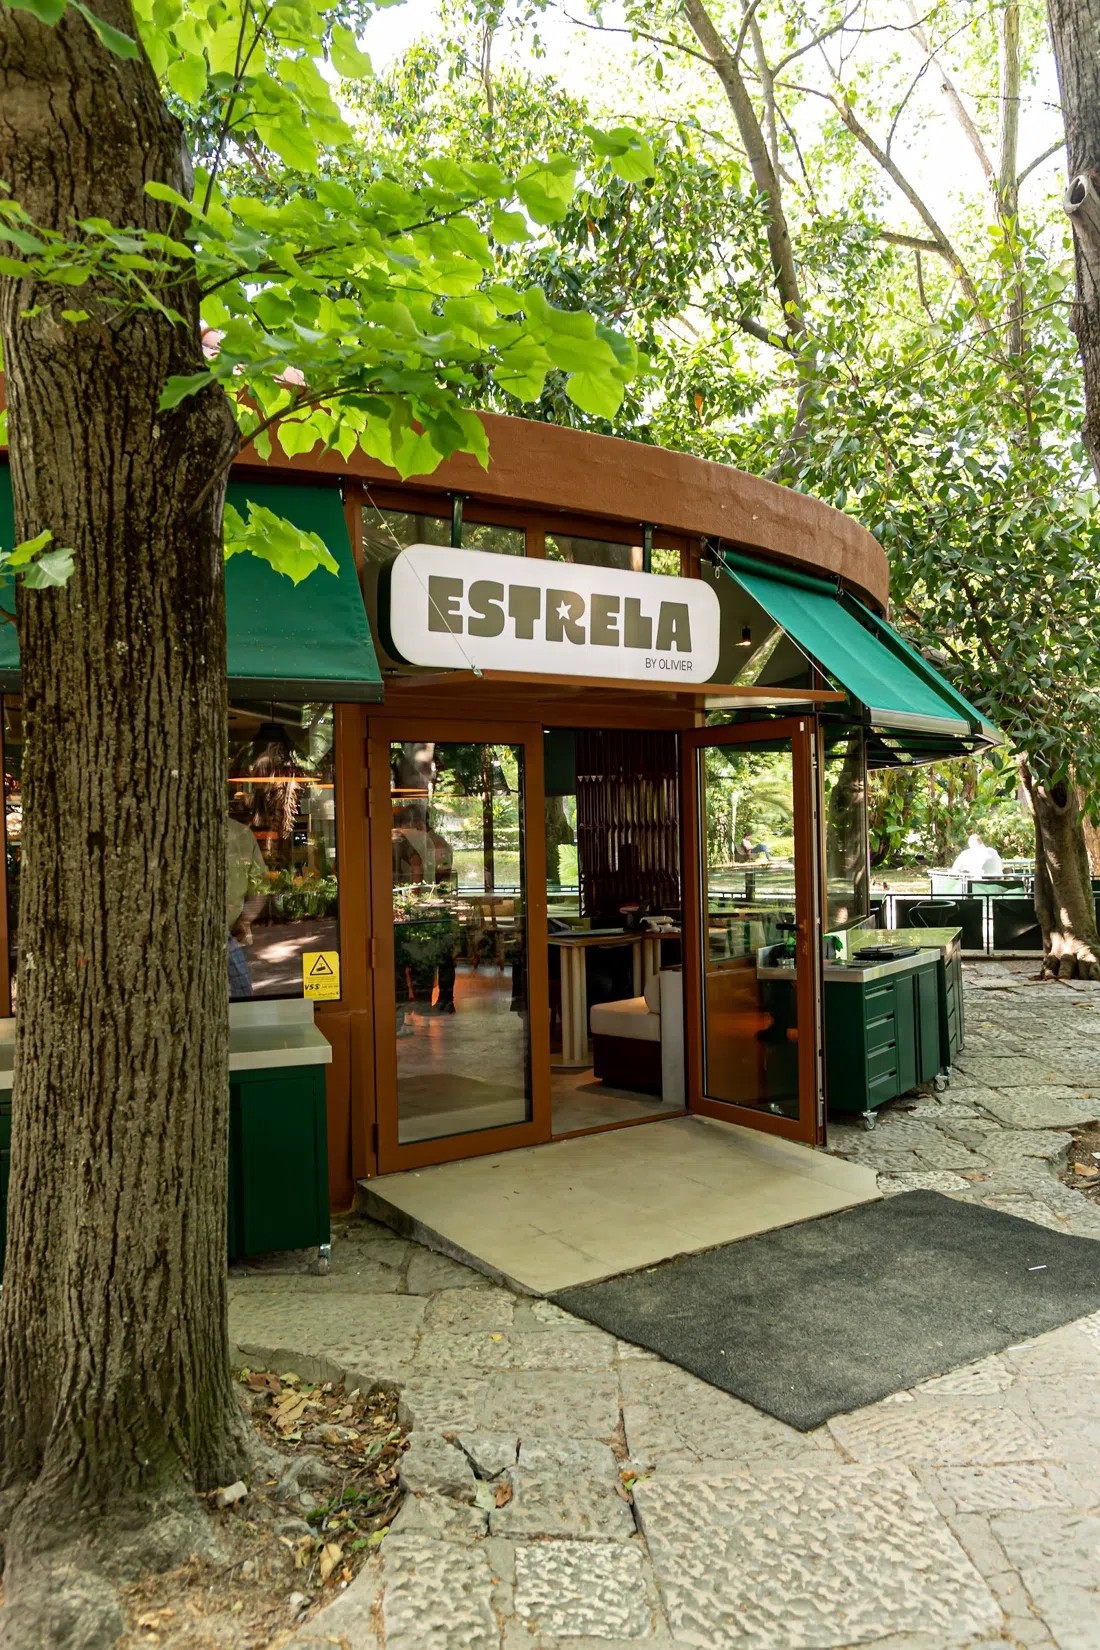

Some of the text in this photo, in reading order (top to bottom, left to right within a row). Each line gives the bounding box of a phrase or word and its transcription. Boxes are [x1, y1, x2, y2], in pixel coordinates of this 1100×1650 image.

[428, 575, 692, 653] ESTRELA
[645, 657, 692, 671] BY OLIVIER
